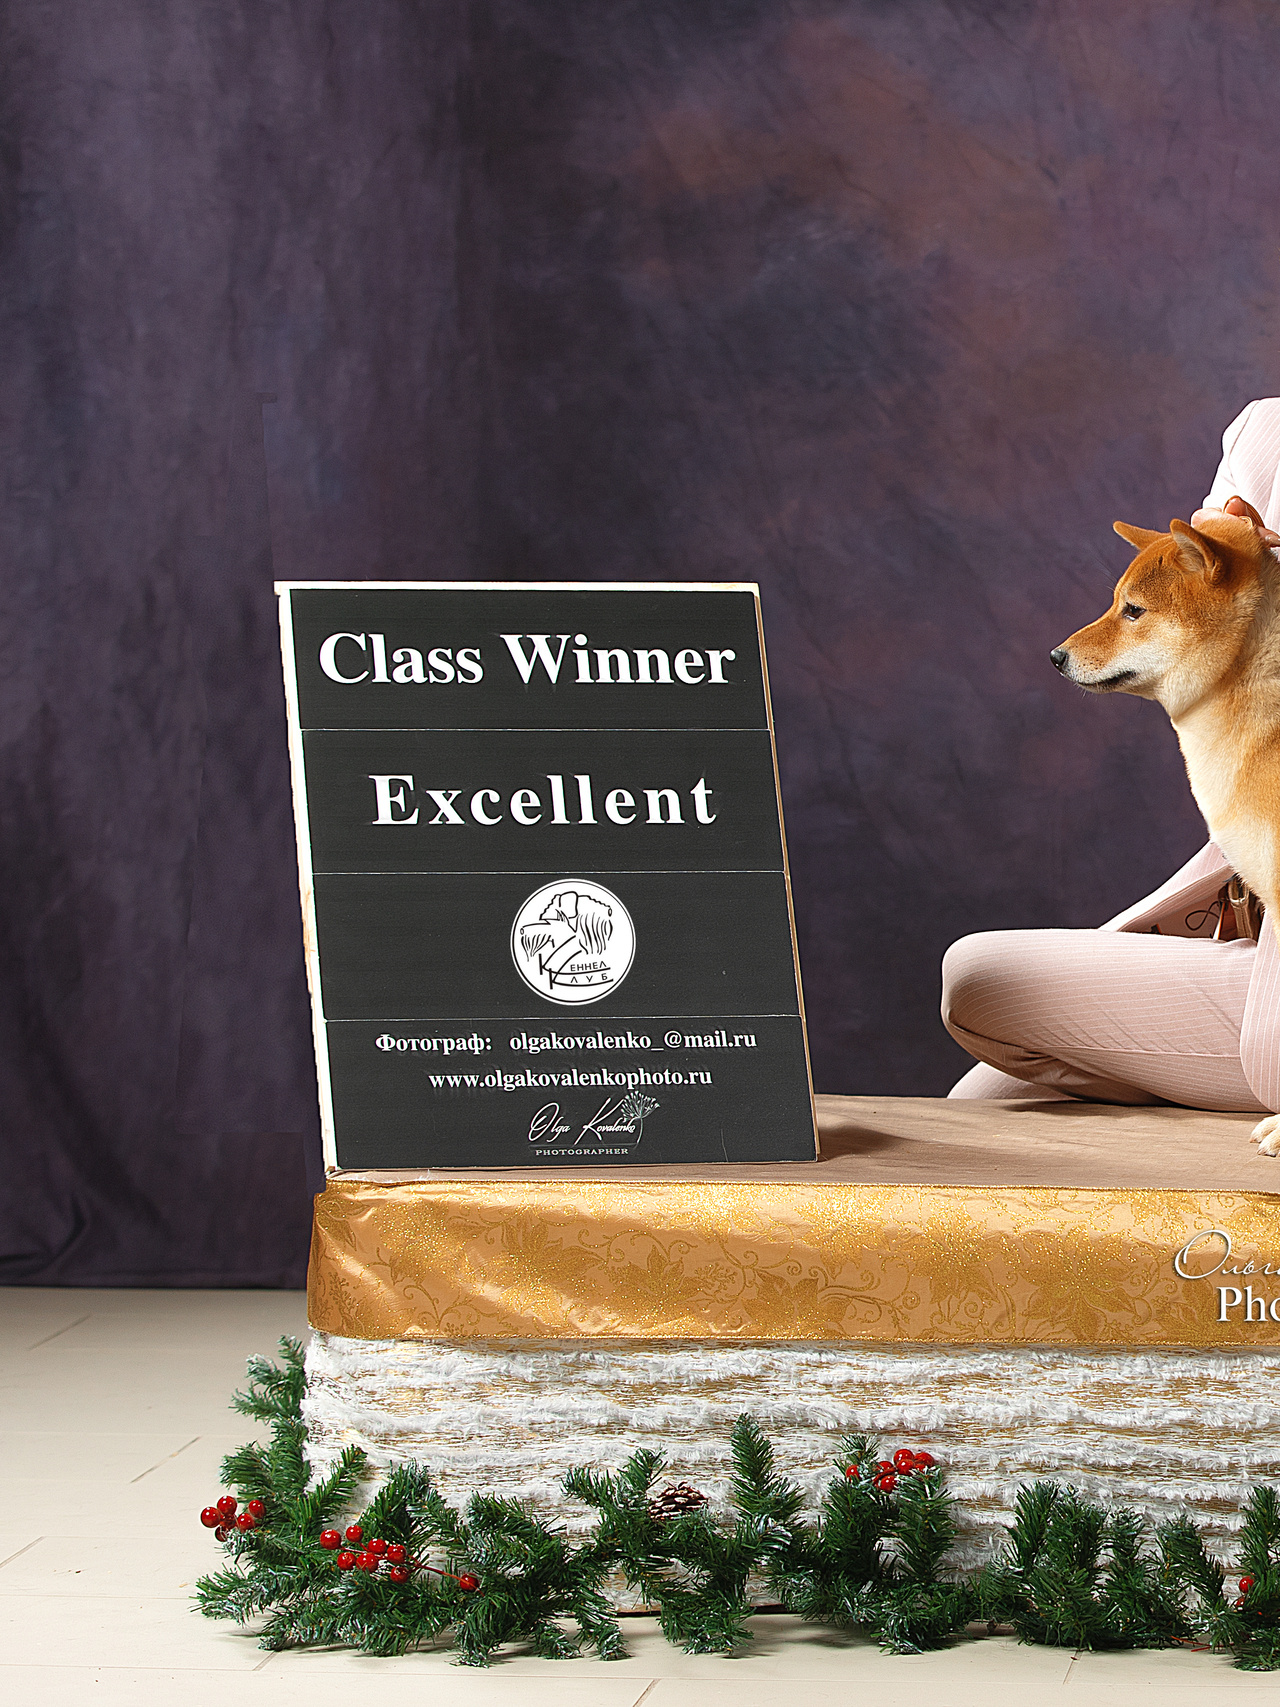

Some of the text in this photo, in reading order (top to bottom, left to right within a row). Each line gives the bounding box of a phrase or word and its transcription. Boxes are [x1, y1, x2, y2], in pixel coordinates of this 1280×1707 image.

[319, 632, 736, 684] Class Winner
[368, 774, 717, 829] Excellent
[375, 1030, 758, 1056] Фотограф: olgakovalenko_@mail.ru
[428, 1067, 713, 1091] www.olgakovalenkophoto.ru
[528, 1098, 636, 1146] Olga Kovalenko
[535, 1148, 629, 1156] PHOTOGRAPHER
